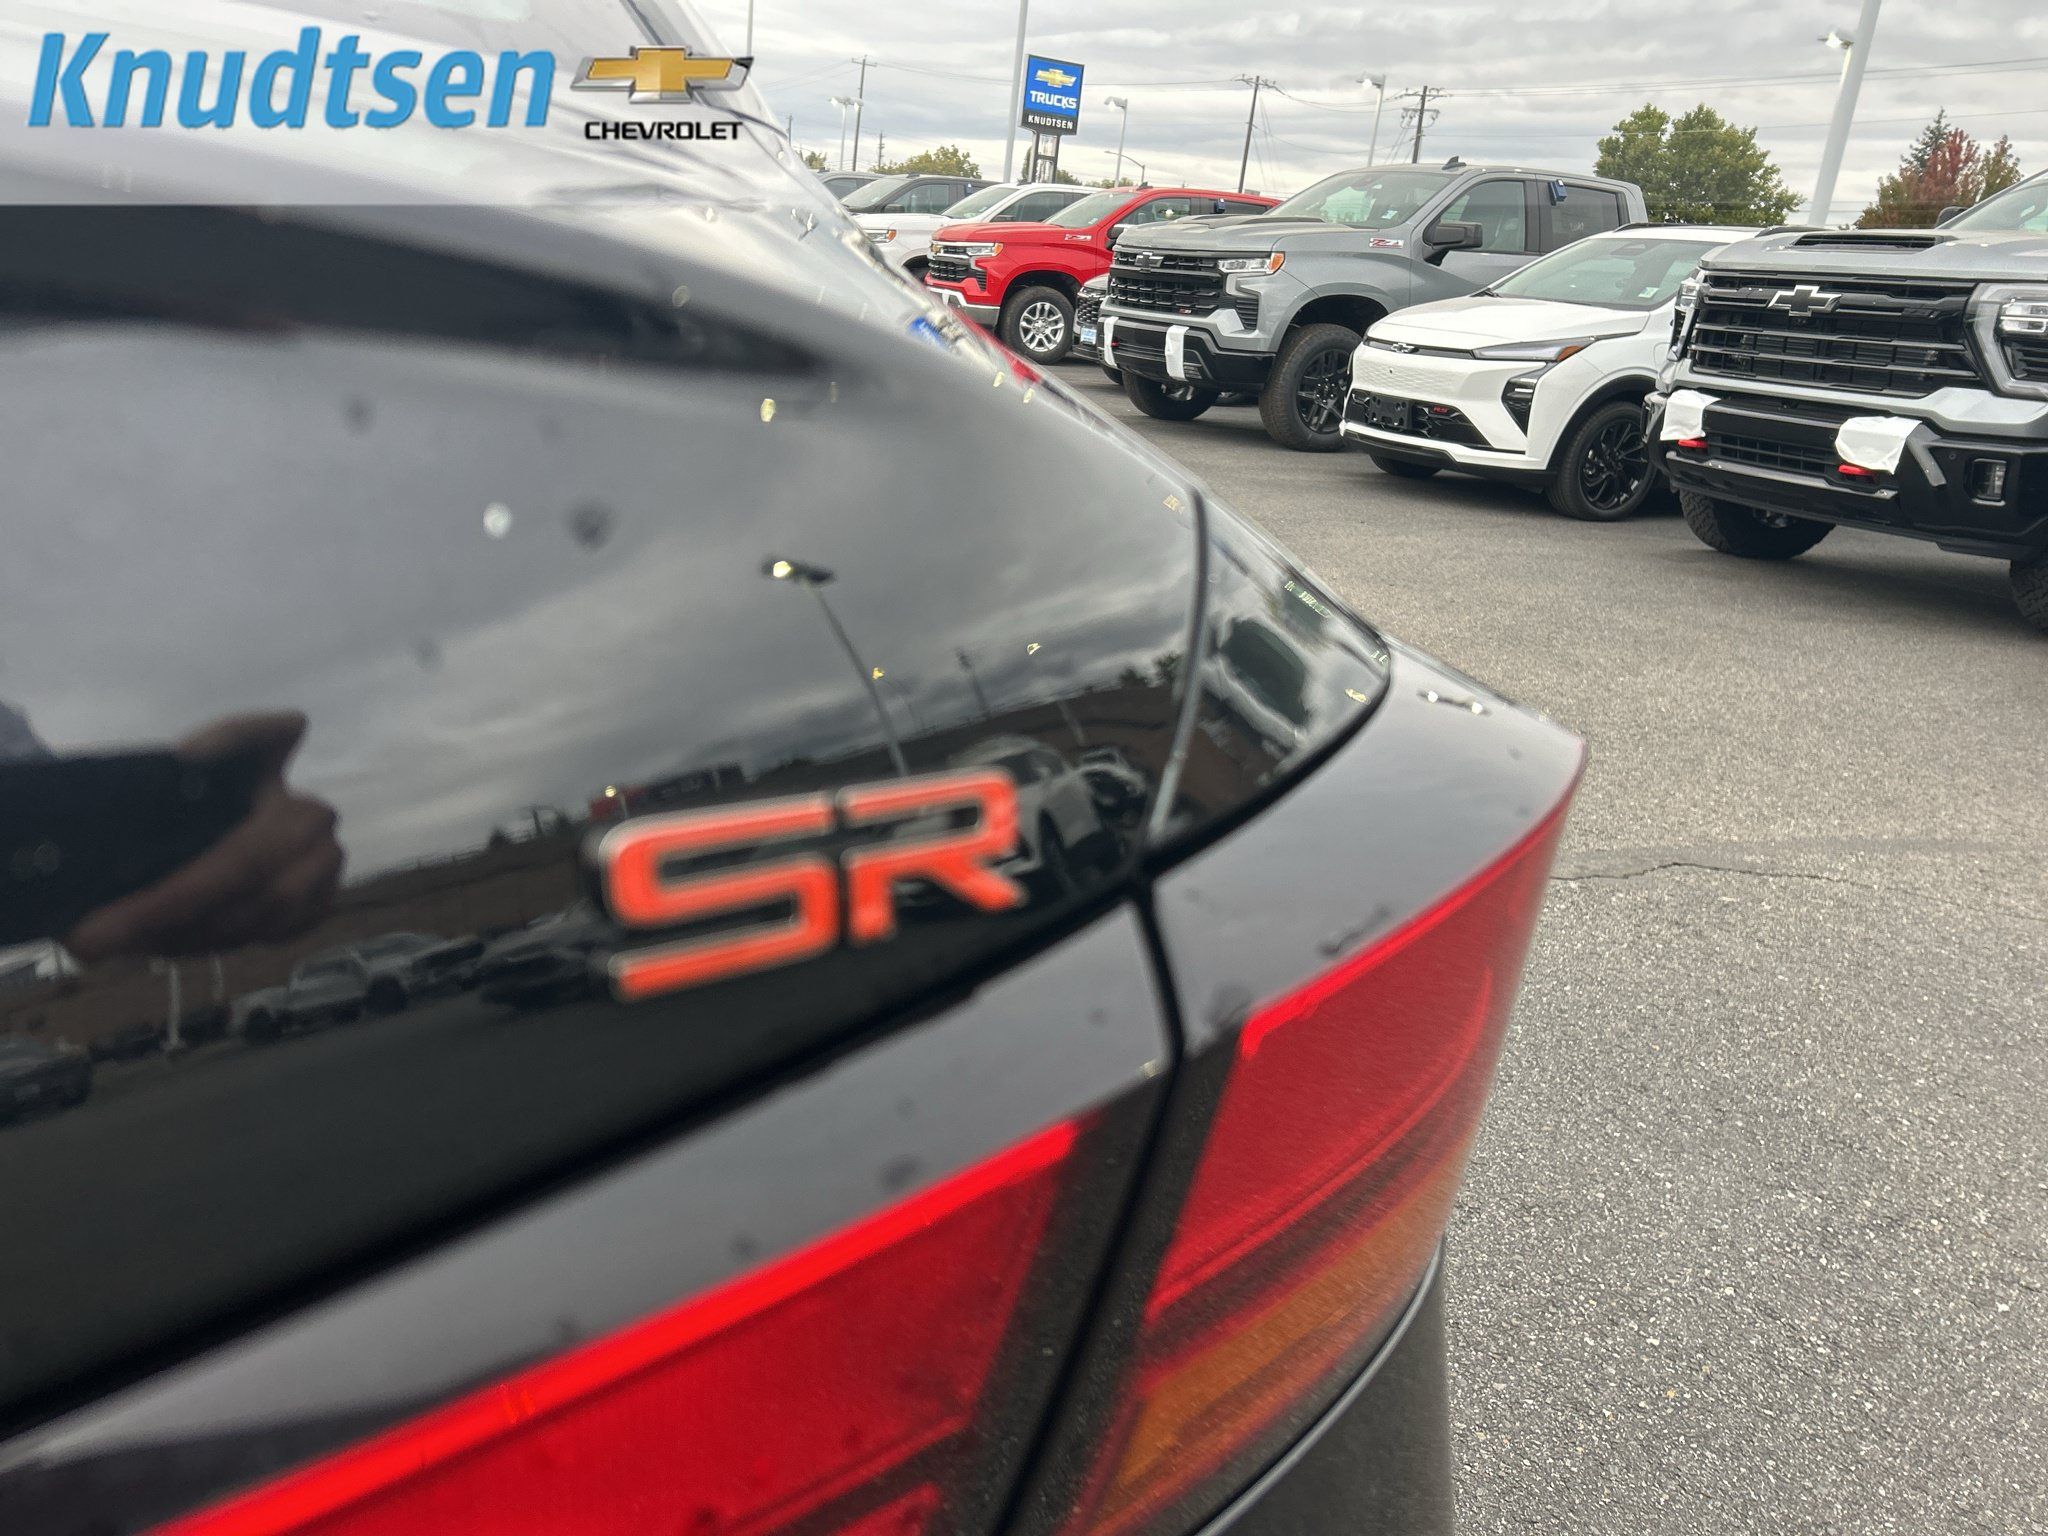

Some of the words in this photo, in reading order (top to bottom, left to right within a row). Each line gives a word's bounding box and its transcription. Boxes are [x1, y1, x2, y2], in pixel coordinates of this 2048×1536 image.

[1029, 90, 1077, 109] TRUCKS
[1028, 115, 1073, 129] KNUDTSEN
[602, 768, 1025, 999] SR
